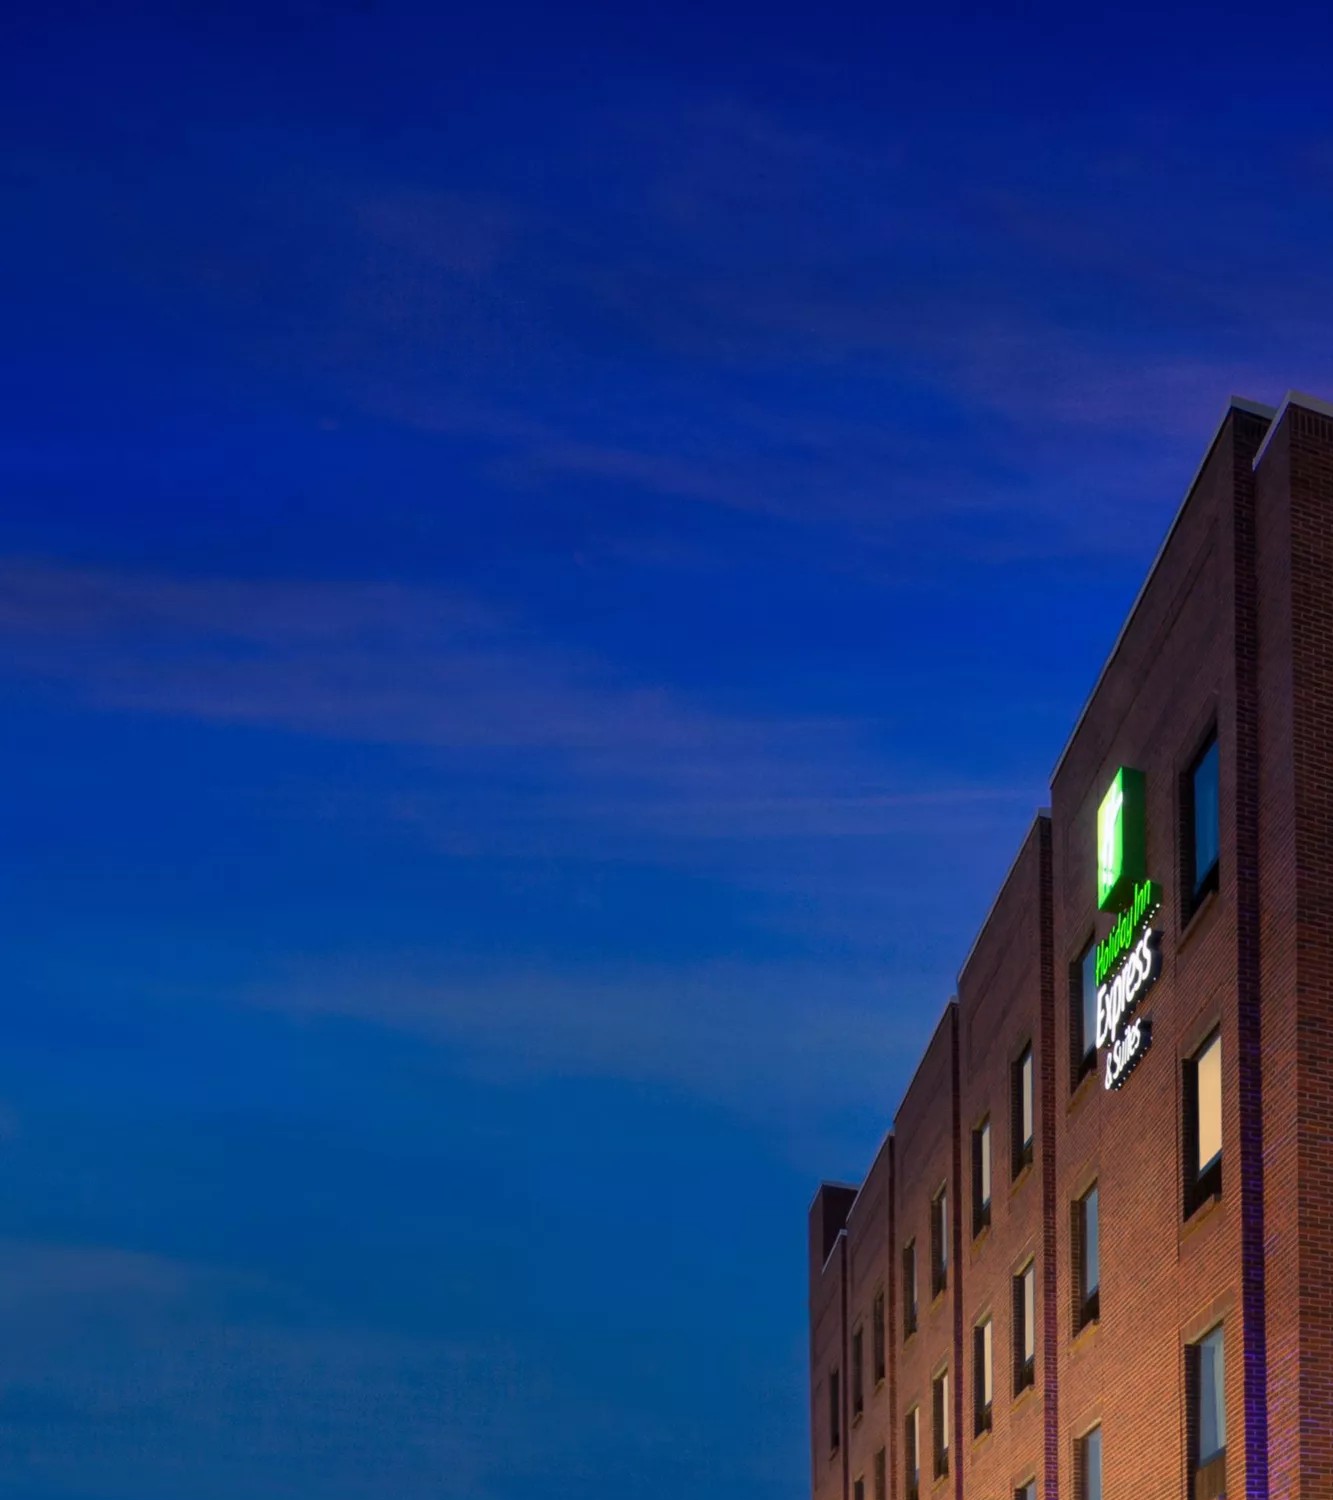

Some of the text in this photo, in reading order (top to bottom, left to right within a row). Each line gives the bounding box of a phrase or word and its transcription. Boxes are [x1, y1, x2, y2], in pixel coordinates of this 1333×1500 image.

[1096, 911, 1132, 987] Holiday
[1134, 880, 1150, 922] Inn
[1096, 928, 1152, 1047] Express
[1104, 1018, 1141, 1090] & Suites
